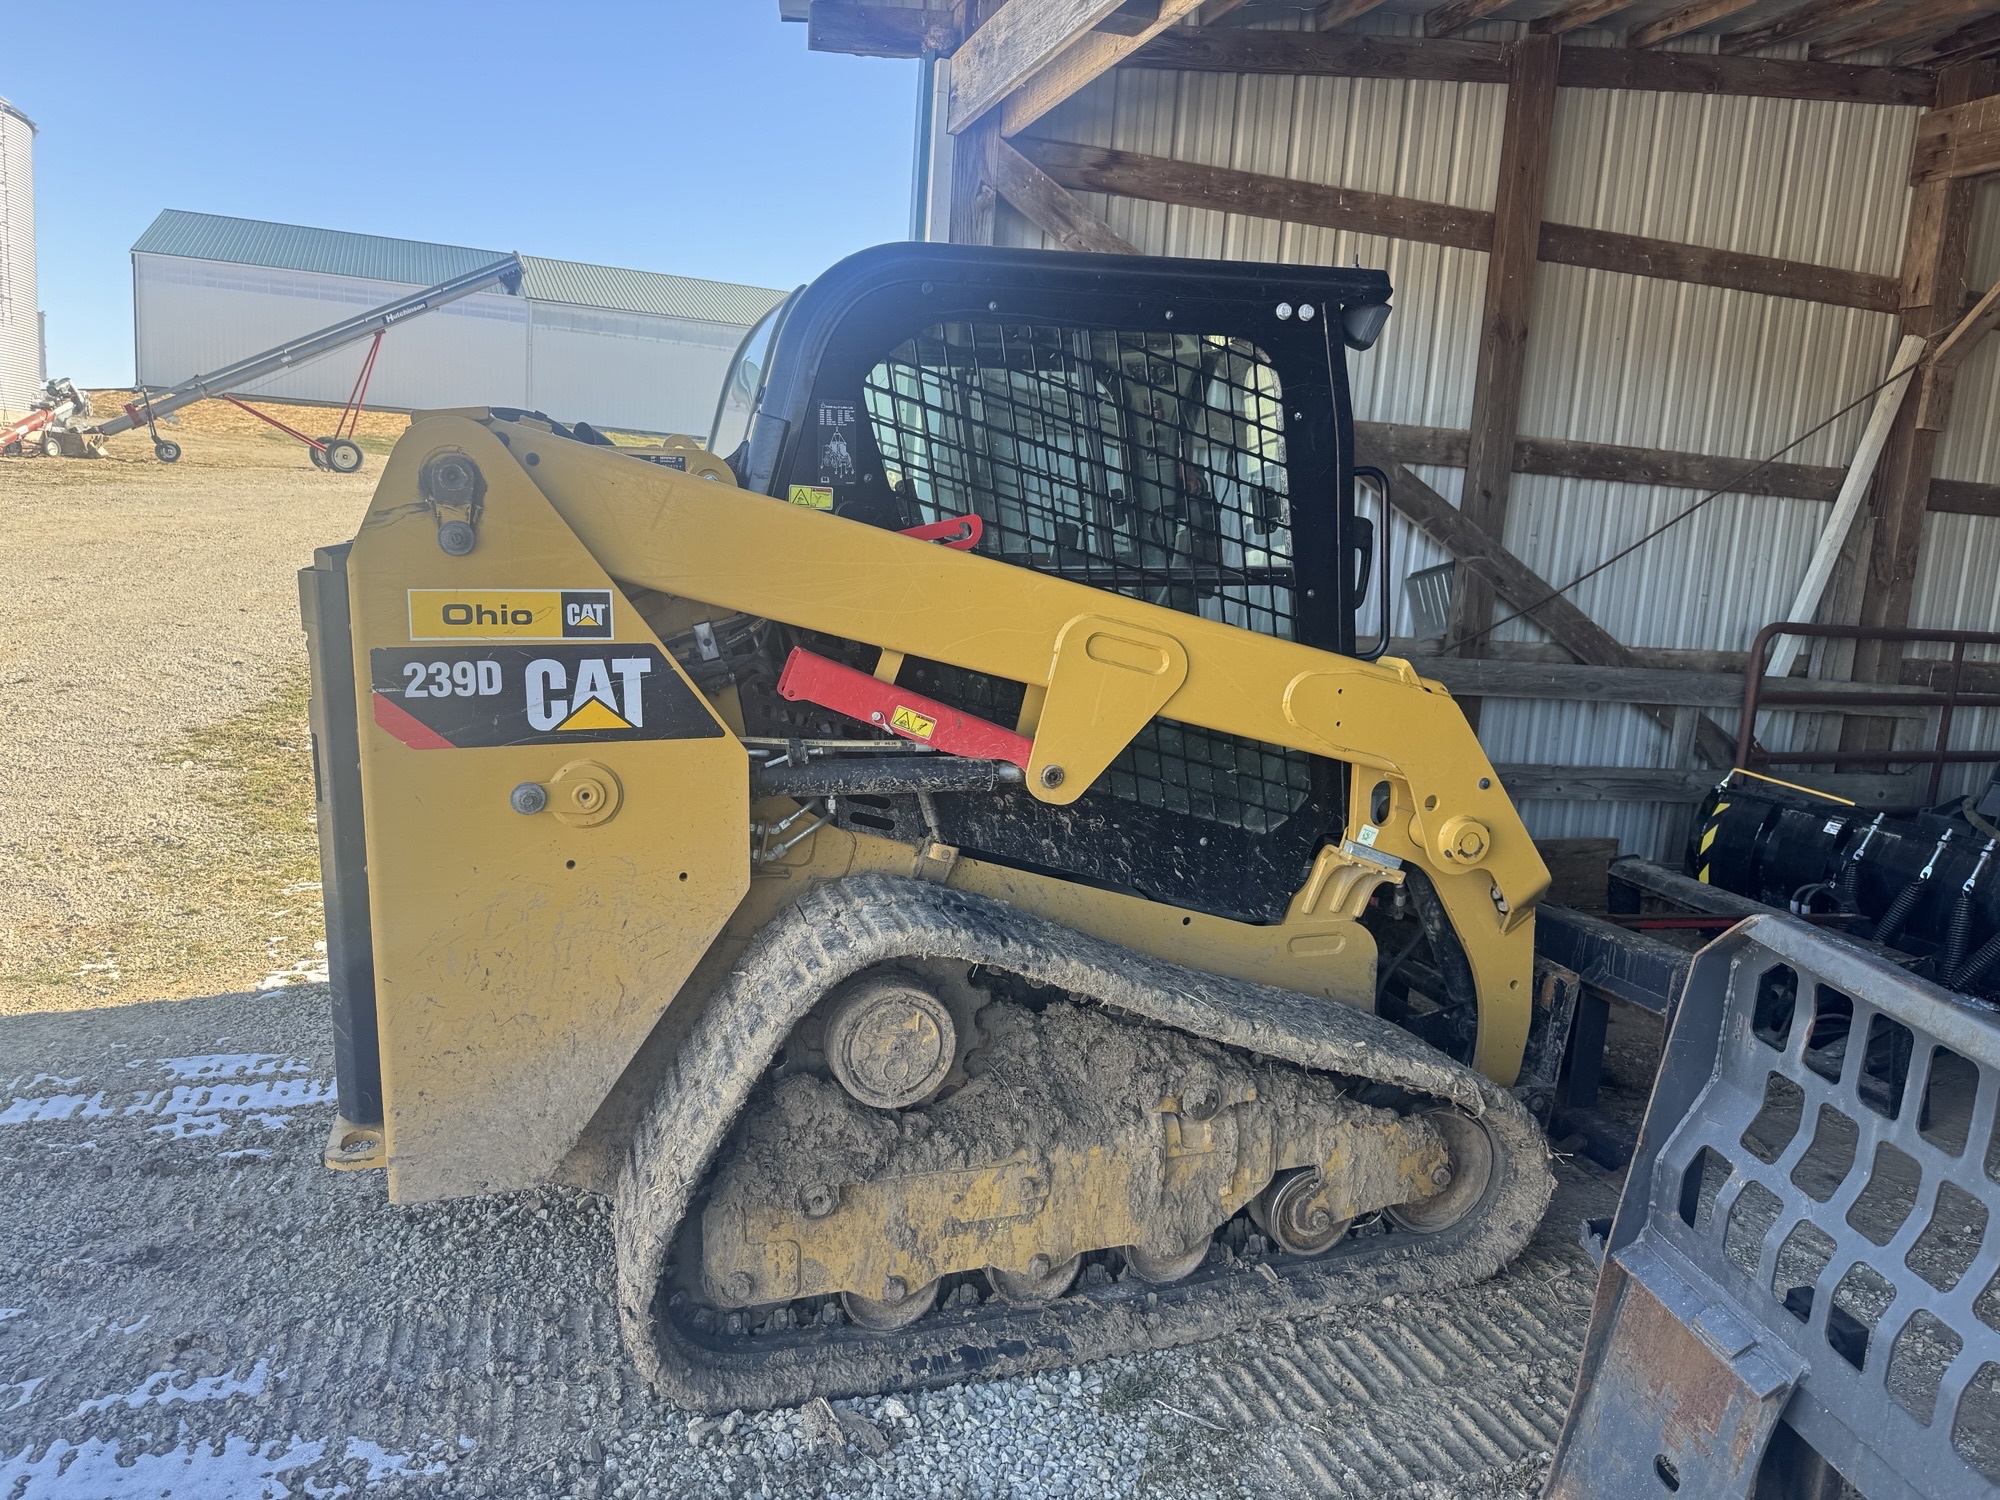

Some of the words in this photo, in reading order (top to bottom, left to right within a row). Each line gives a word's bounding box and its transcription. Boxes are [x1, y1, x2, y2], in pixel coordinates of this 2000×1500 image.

[385, 303, 426, 323] Hutchinson
[442, 603, 533, 626] Ohio
[566, 602, 606, 626] CAT
[403, 660, 503, 698] 239D
[525, 657, 651, 732] CAT
